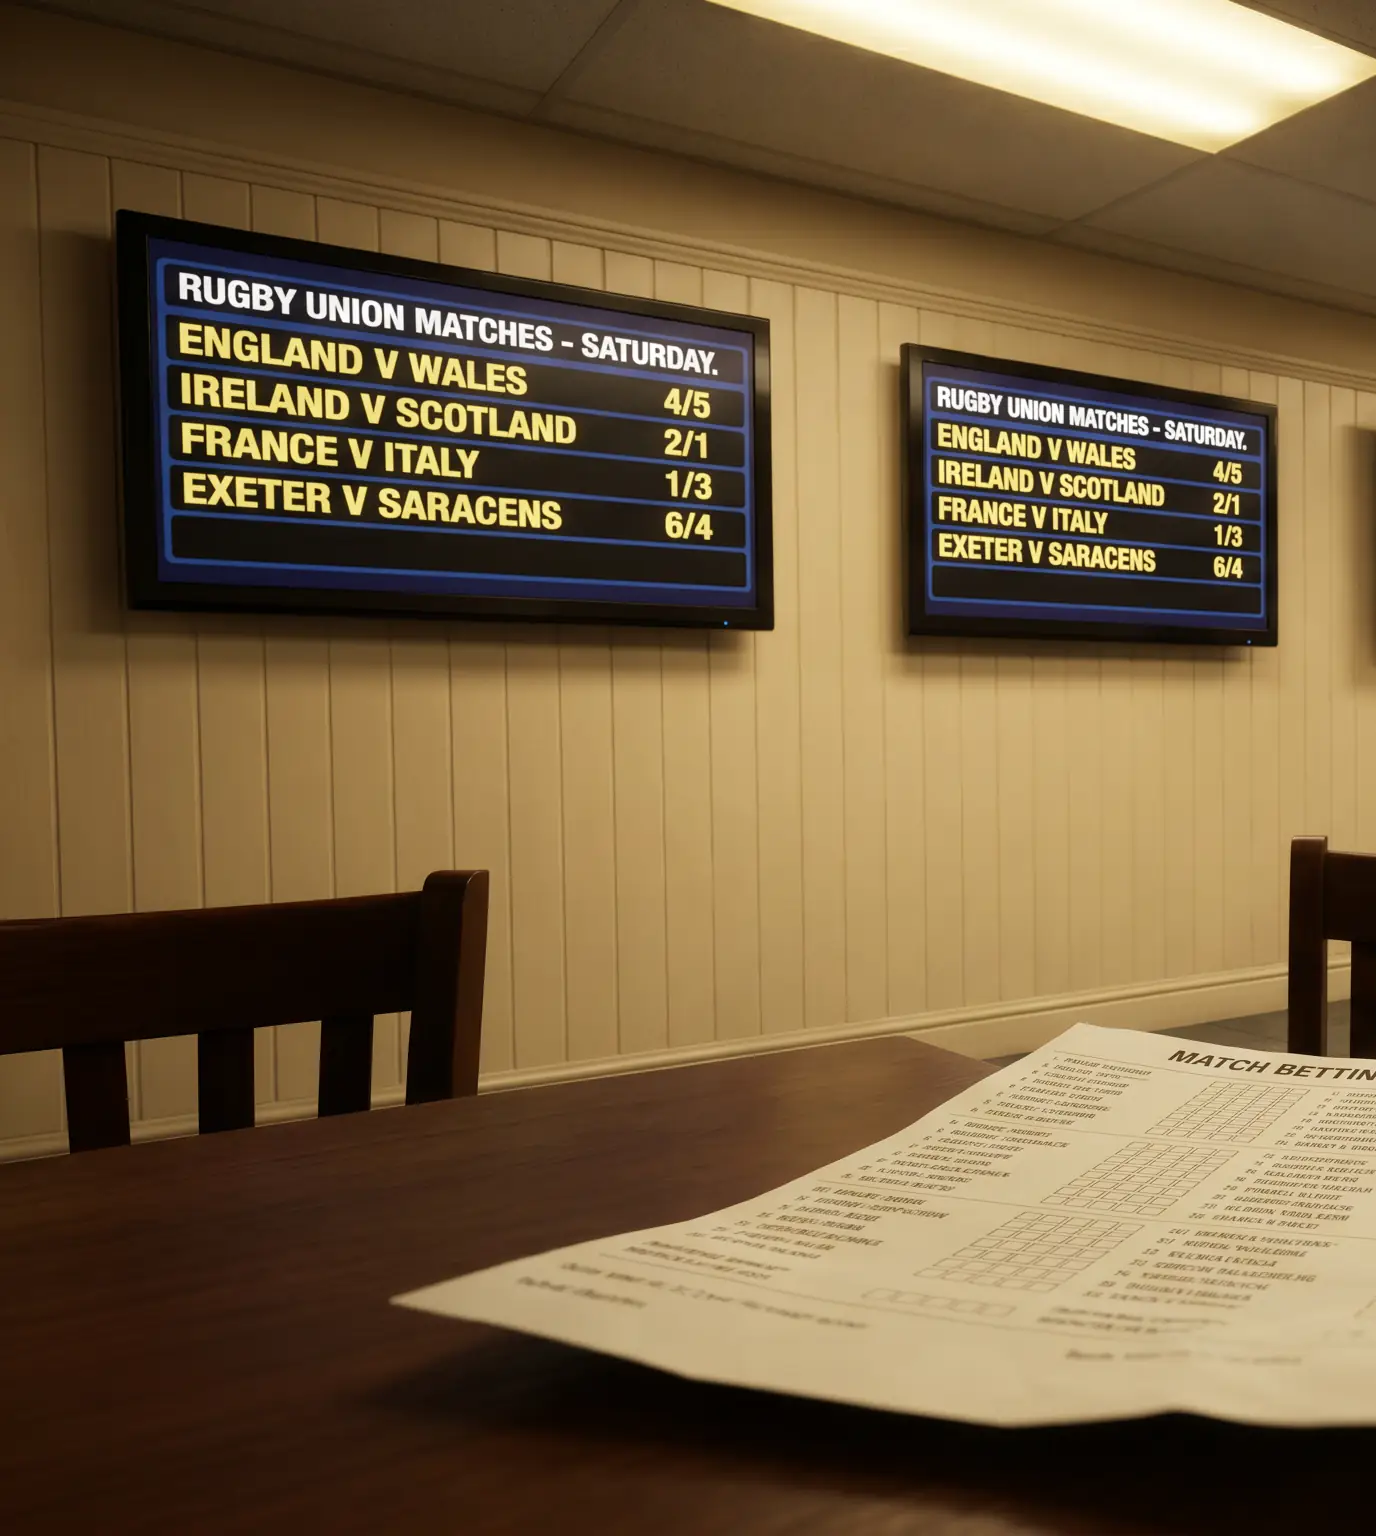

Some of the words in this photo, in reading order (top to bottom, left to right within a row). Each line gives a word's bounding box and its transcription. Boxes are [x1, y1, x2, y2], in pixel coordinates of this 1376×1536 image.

[179, 272, 297, 314] RUGBY
[306, 291, 404, 331] UNION
[415, 307, 553, 351] MATCHES
[581, 332, 718, 375] SATURDAY.
[180, 322, 362, 374] ENGLAND
[374, 348, 398, 379] V
[409, 353, 527, 395] WALES
[664, 388, 710, 418] 4/5
[181, 373, 349, 420] IRELAND
[360, 393, 385, 424] V
[396, 397, 576, 444] SCOTLAND
[664, 429, 707, 458] 2/1
[937, 386, 1003, 415] RUGBY
[1008, 396, 1064, 424] UNION
[1069, 405, 1149, 436] MATCHES
[1165, 420, 1247, 450] SATURDAY.
[182, 422, 338, 466] FRANCE
[348, 438, 373, 469] V
[385, 442, 479, 478] ITALY
[666, 470, 712, 500] 1/3
[938, 423, 1041, 458] ENGLAND
[1047, 437, 1062, 460] V
[1066, 440, 1136, 470] WALES
[1213, 461, 1242, 484] 4/5
[183, 472, 331, 513] EXETER
[342, 485, 367, 515] V
[379, 488, 562, 529] SARACENS
[665, 512, 713, 540] 6/4
[939, 459, 1034, 492] IRELAND
[1039, 471, 1054, 494] V
[1060, 474, 1164, 506] SCOTLAND
[1213, 492, 1239, 515] 2/1
[939, 496, 1026, 527] FRANCE
[1031, 506, 1047, 529] V
[1053, 507, 1108, 534] ITALY
[1214, 524, 1242, 547] 1/3
[939, 533, 1022, 562] EXETER
[1028, 540, 1043, 563] V
[1049, 542, 1156, 572] SARACENS
[1214, 556, 1243, 578] 6/4
[1168, 1050, 1271, 1073] MATCH
